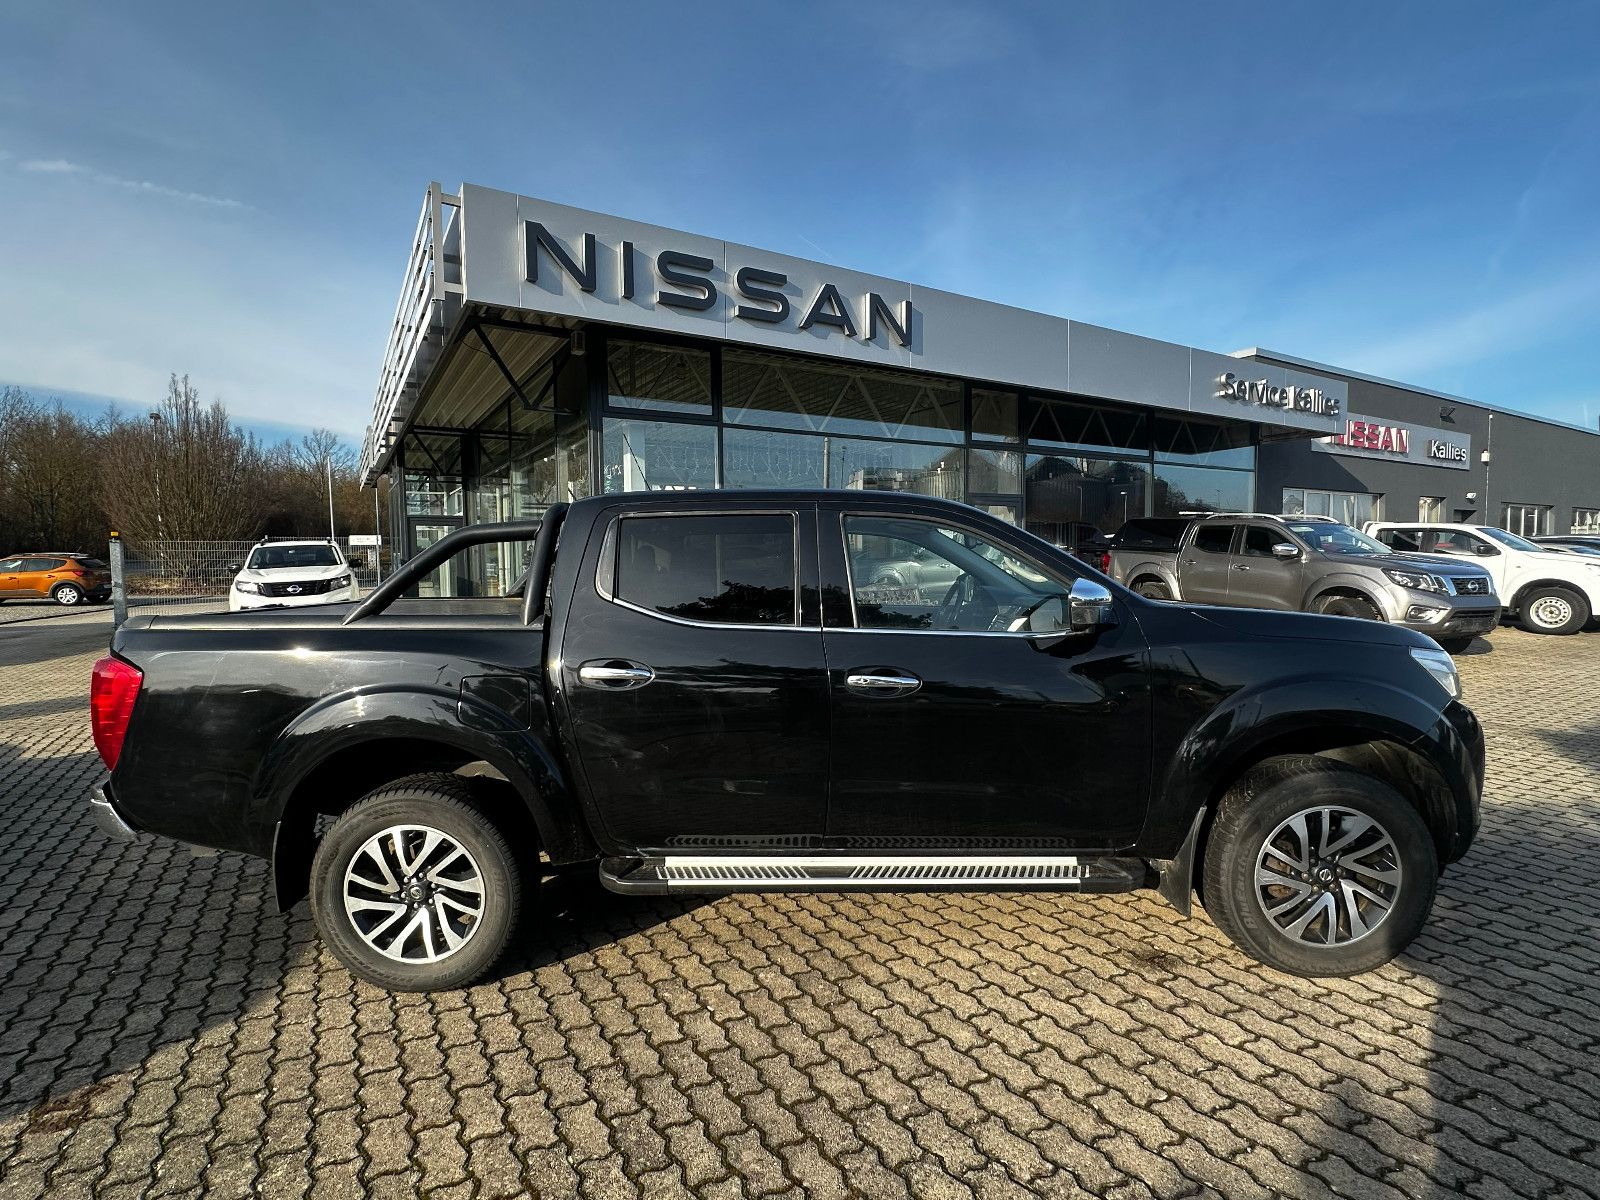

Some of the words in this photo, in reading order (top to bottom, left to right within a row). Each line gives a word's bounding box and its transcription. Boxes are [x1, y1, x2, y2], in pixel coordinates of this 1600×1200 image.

[523, 219, 912, 347] NISSAN
[1217, 372, 1288, 407] Service
[1288, 385, 1340, 416] Kallies
[1430, 439, 1467, 461] Kallies
